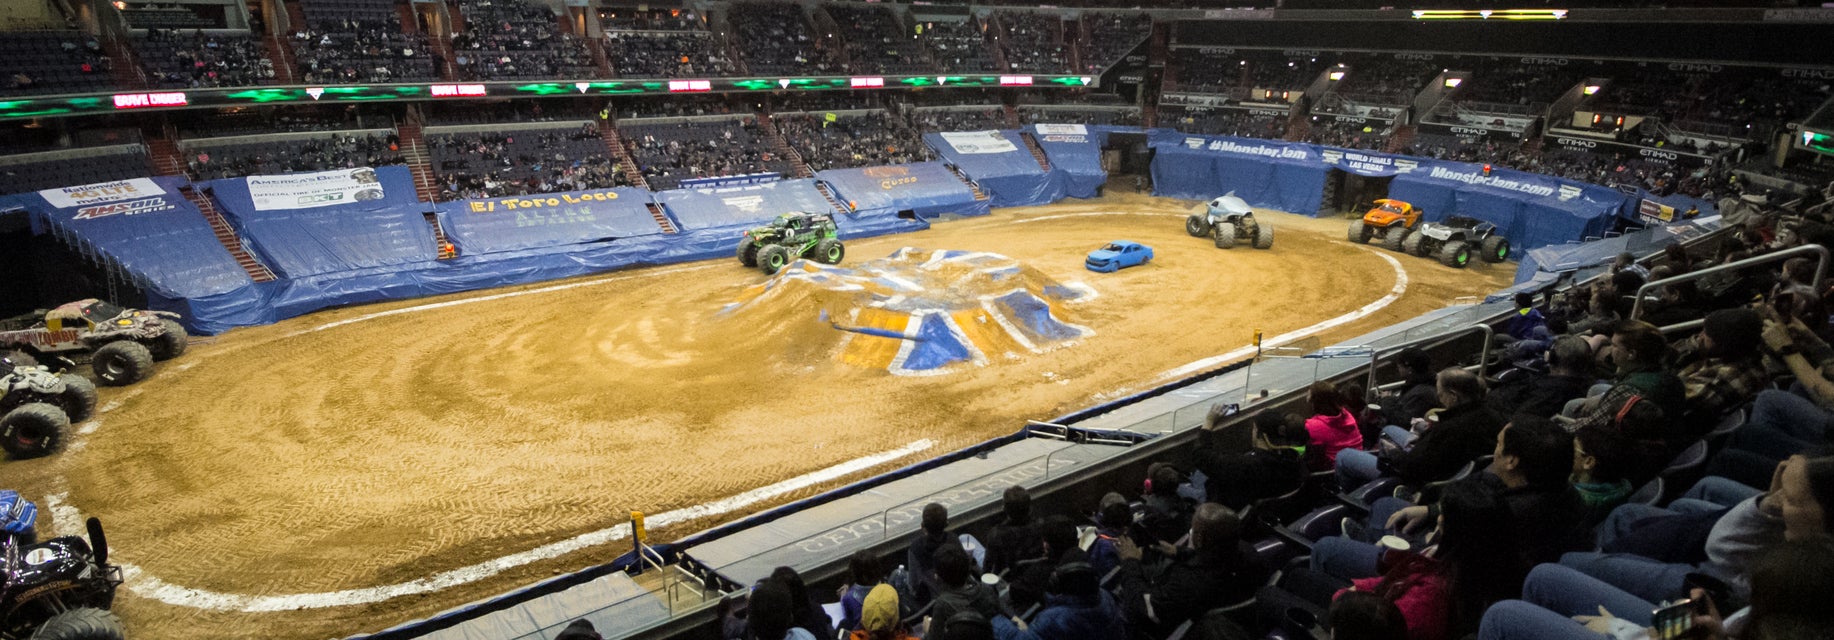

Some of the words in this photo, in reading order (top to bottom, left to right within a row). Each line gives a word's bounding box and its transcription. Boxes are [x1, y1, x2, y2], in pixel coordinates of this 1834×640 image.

[1520, 57, 1568, 66] ETIHAD
[1668, 63, 1722, 73] ETIHAD
[1335, 116, 1366, 124] ETIHAD
[1450, 126, 1488, 136] ETIHAD
[1557, 138, 1597, 148] ETIHAD
[1208, 139, 1307, 160] #MonsterJam
[1640, 149, 1678, 160] ETIHAD
[1345, 152, 1369, 162] WORLD
[1369, 156, 1392, 165] FINALS
[1349, 161, 1362, 169] LAS
[1362, 162, 1384, 172] VEGAS
[1430, 166, 1554, 197] MonsterJam.com
[62, 181, 131, 194] Nationwide
[101, 184, 138, 196] LTE
[73, 197, 166, 220] AMSOIL
[124, 205, 176, 216] SERIES
[38, 330, 79, 347] ZOMBIE
